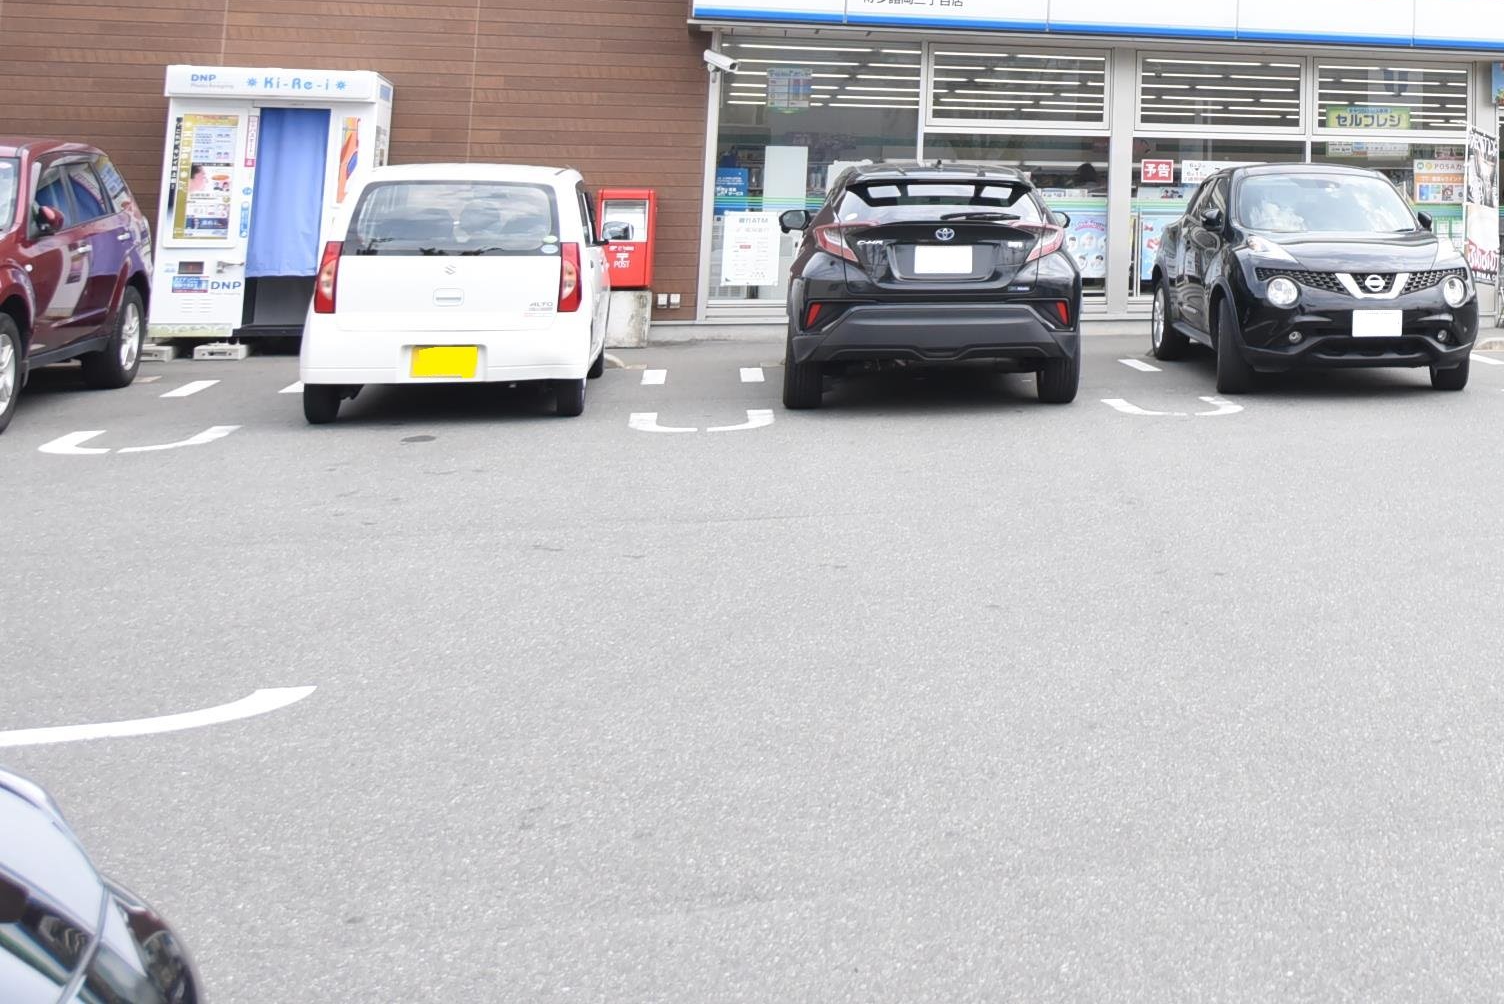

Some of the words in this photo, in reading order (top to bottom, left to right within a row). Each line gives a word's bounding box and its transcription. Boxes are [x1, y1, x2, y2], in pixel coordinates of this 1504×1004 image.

[191, 74, 216, 82] DNP
[1143, 163, 1171, 178] 予告
[613, 260, 631, 269] POST
[210, 280, 242, 291] DNP
